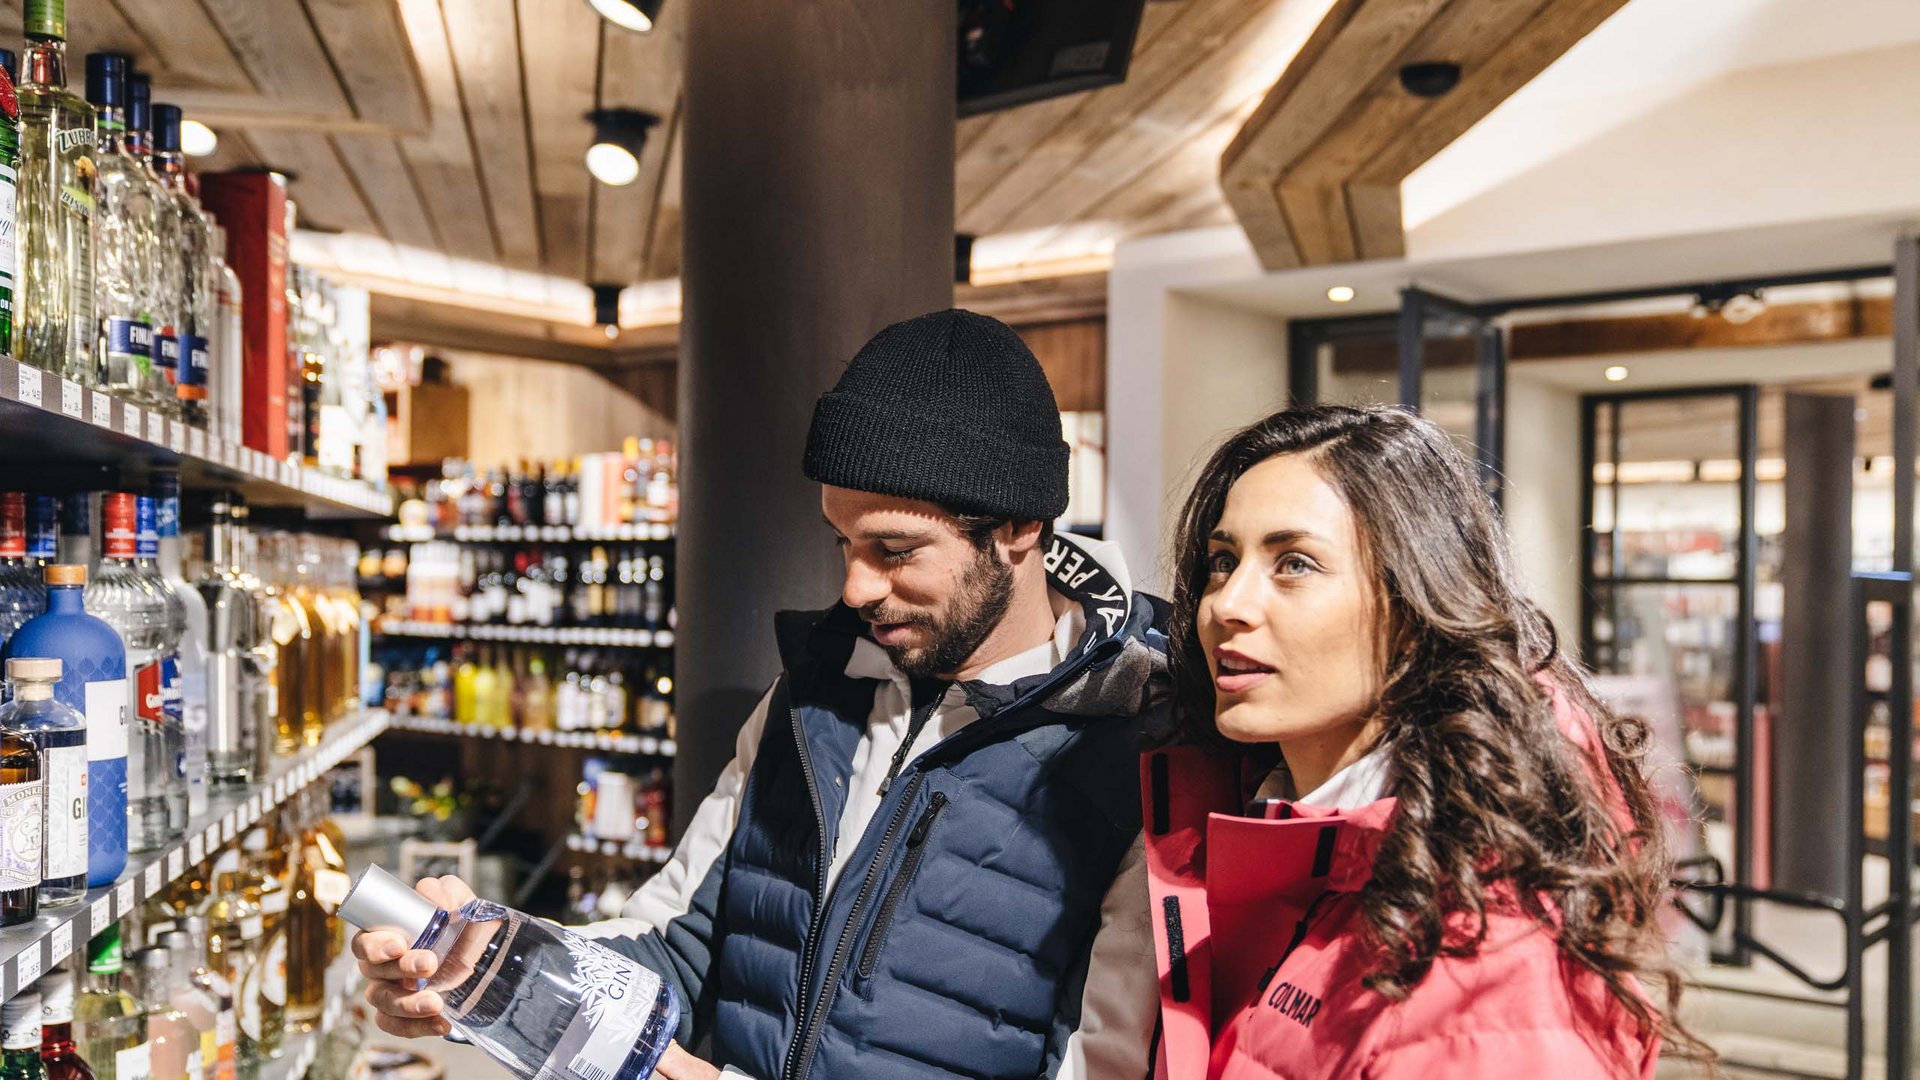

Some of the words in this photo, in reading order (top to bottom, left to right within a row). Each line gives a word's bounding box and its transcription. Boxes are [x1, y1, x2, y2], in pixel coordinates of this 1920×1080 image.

[1043, 539, 1100, 590] PER
[607, 963, 632, 1000] GIN
[1268, 981, 1322, 1028] COLMAR
